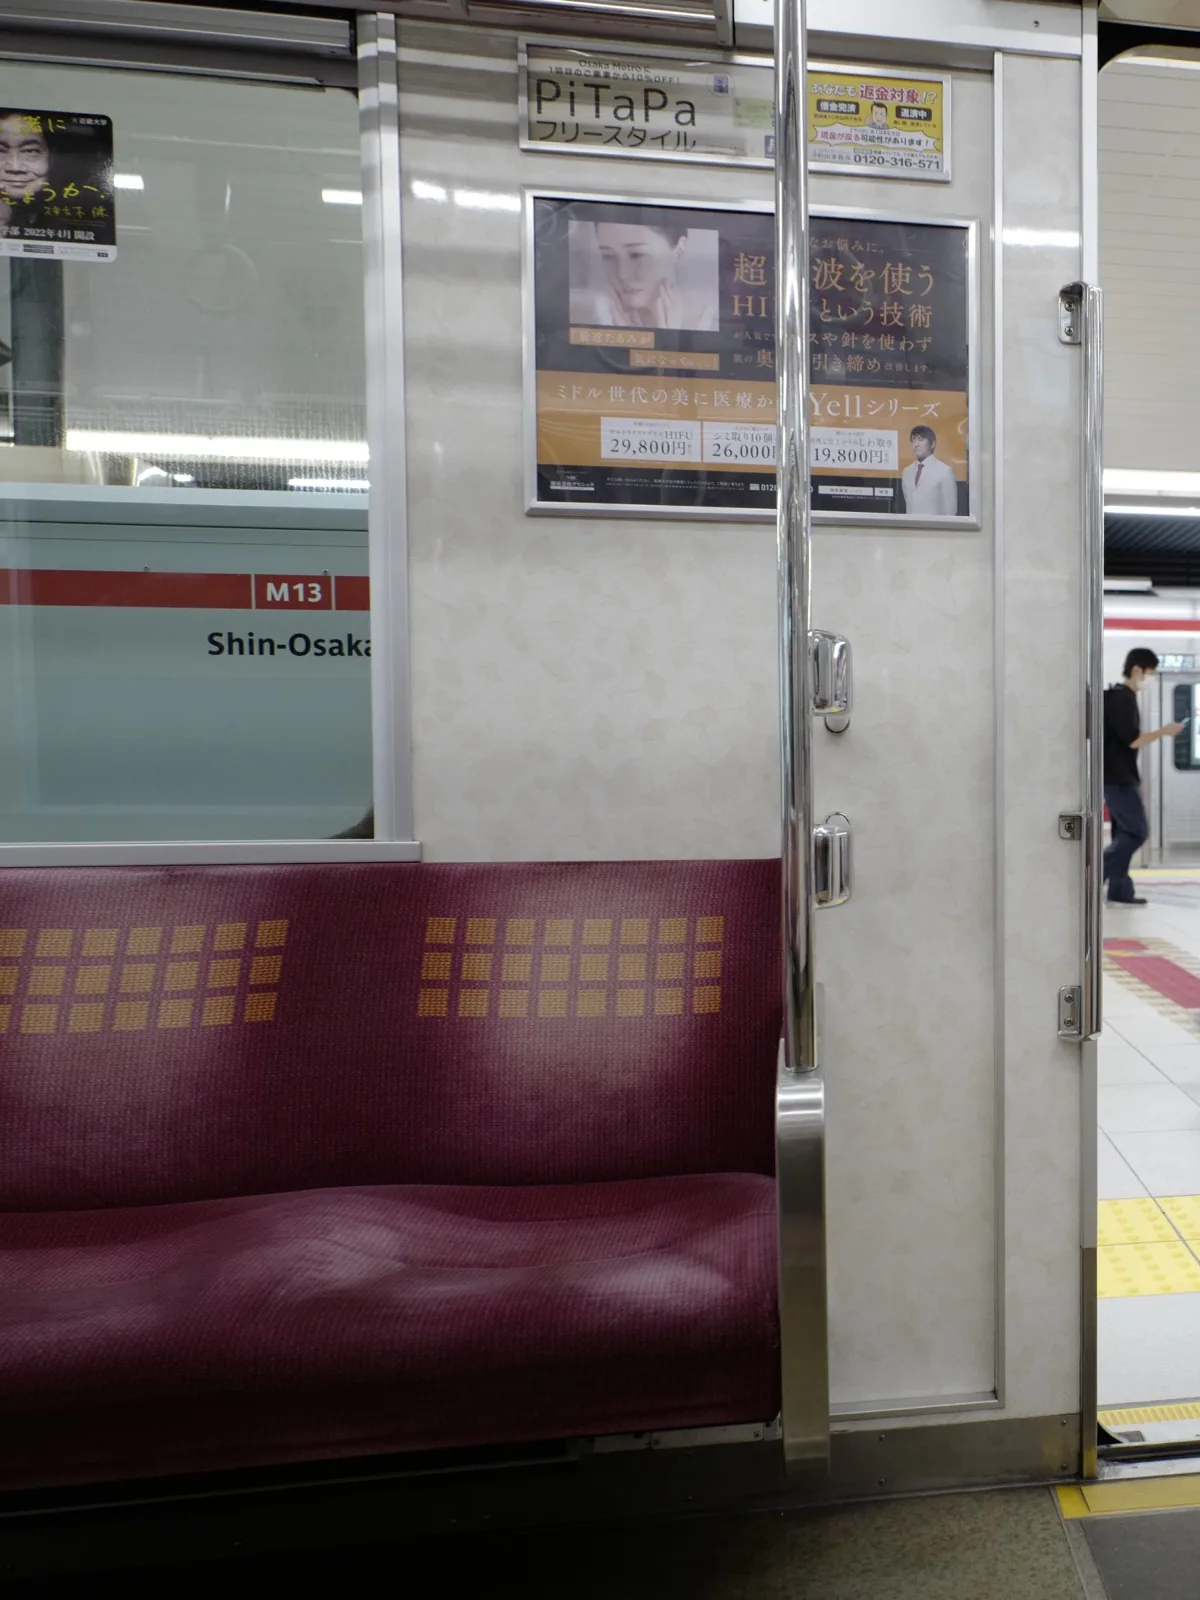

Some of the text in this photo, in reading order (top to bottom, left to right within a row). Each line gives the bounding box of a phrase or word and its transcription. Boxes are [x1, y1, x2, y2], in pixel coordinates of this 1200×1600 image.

[578, 59, 610, 69] Osaka
[536, 79, 697, 127] PiTaPa
[536, 120, 697, 151] フリースタイル
[853, 153, 941, 170] 0120-316-571
[610, 438, 687, 455] 29,800円
[814, 447, 883, 464] 19,800円
[266, 582, 322, 603] M13
